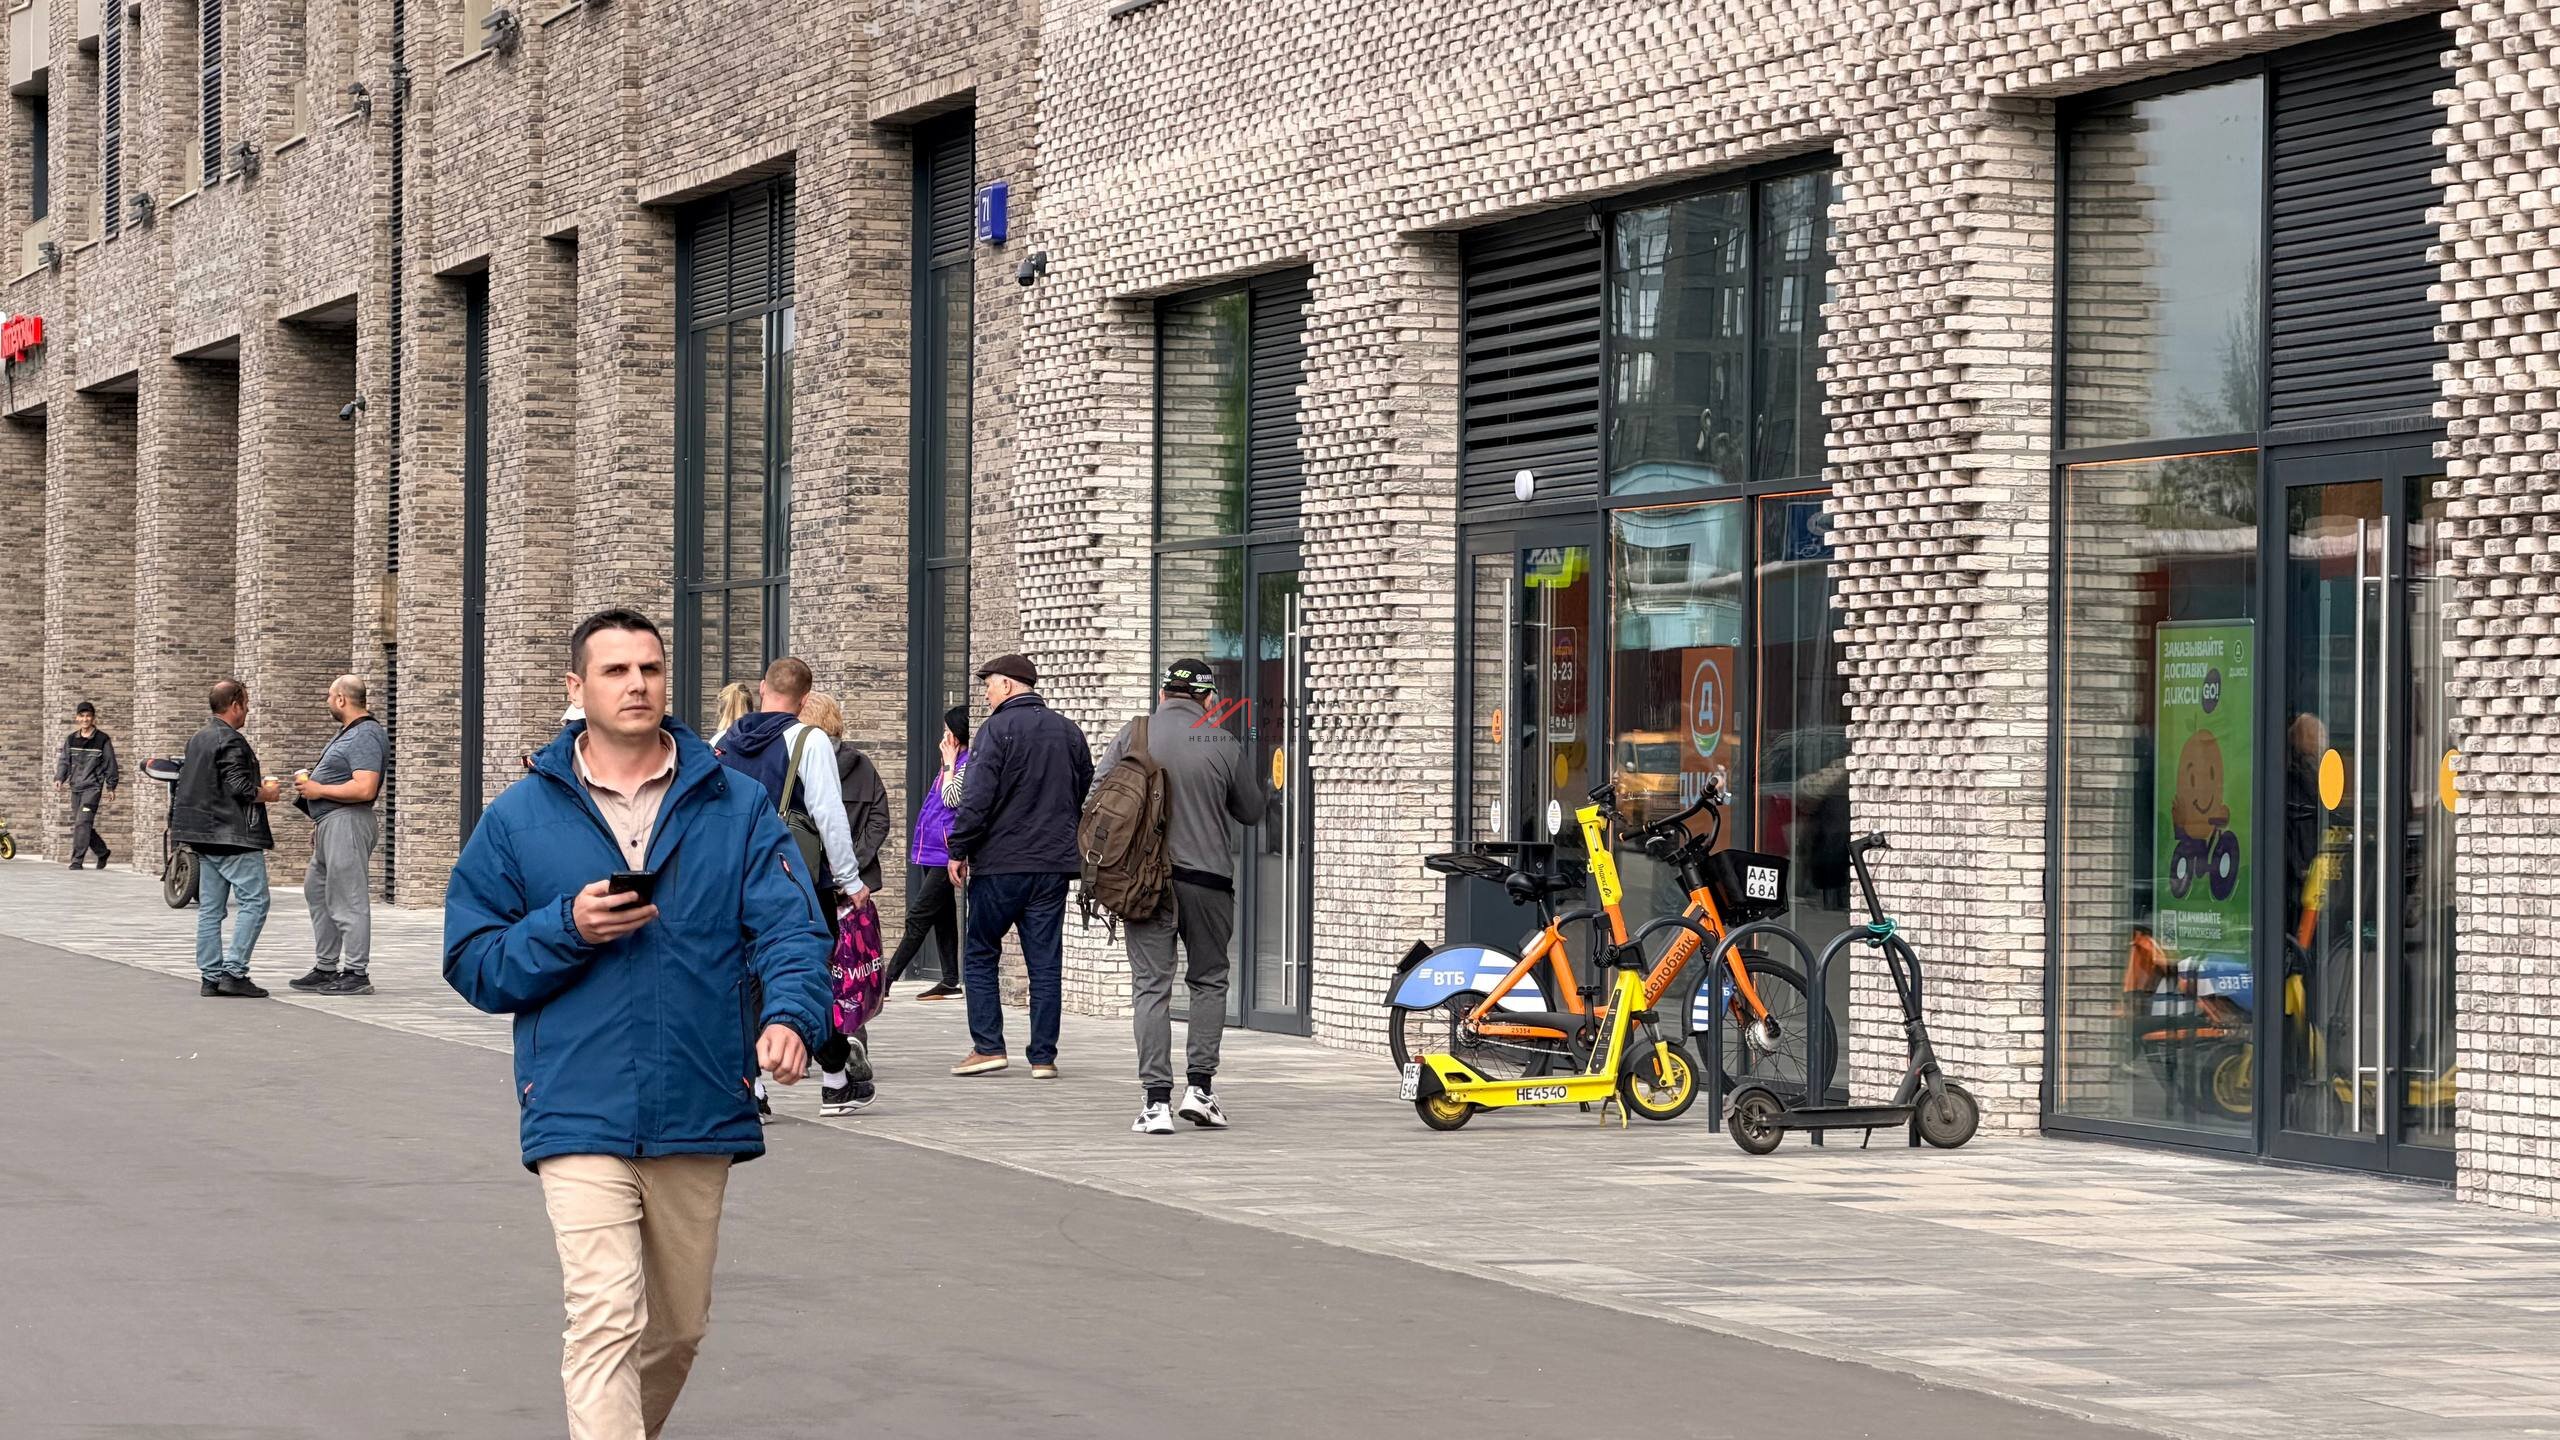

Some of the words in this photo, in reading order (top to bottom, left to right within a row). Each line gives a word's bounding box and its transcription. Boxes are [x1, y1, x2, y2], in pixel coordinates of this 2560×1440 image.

[982, 196, 989, 222] 71
[2163, 636, 2224, 657] ЗАКАЗЫВАЙТЕ
[1173, 669, 1192, 679] 46
[2163, 662, 2208, 680] ДОСТАВКУ
[2202, 682, 2219, 700] GO!
[1644, 935, 1697, 1001] Велобайк
[1433, 971, 1466, 986] ВТБ
